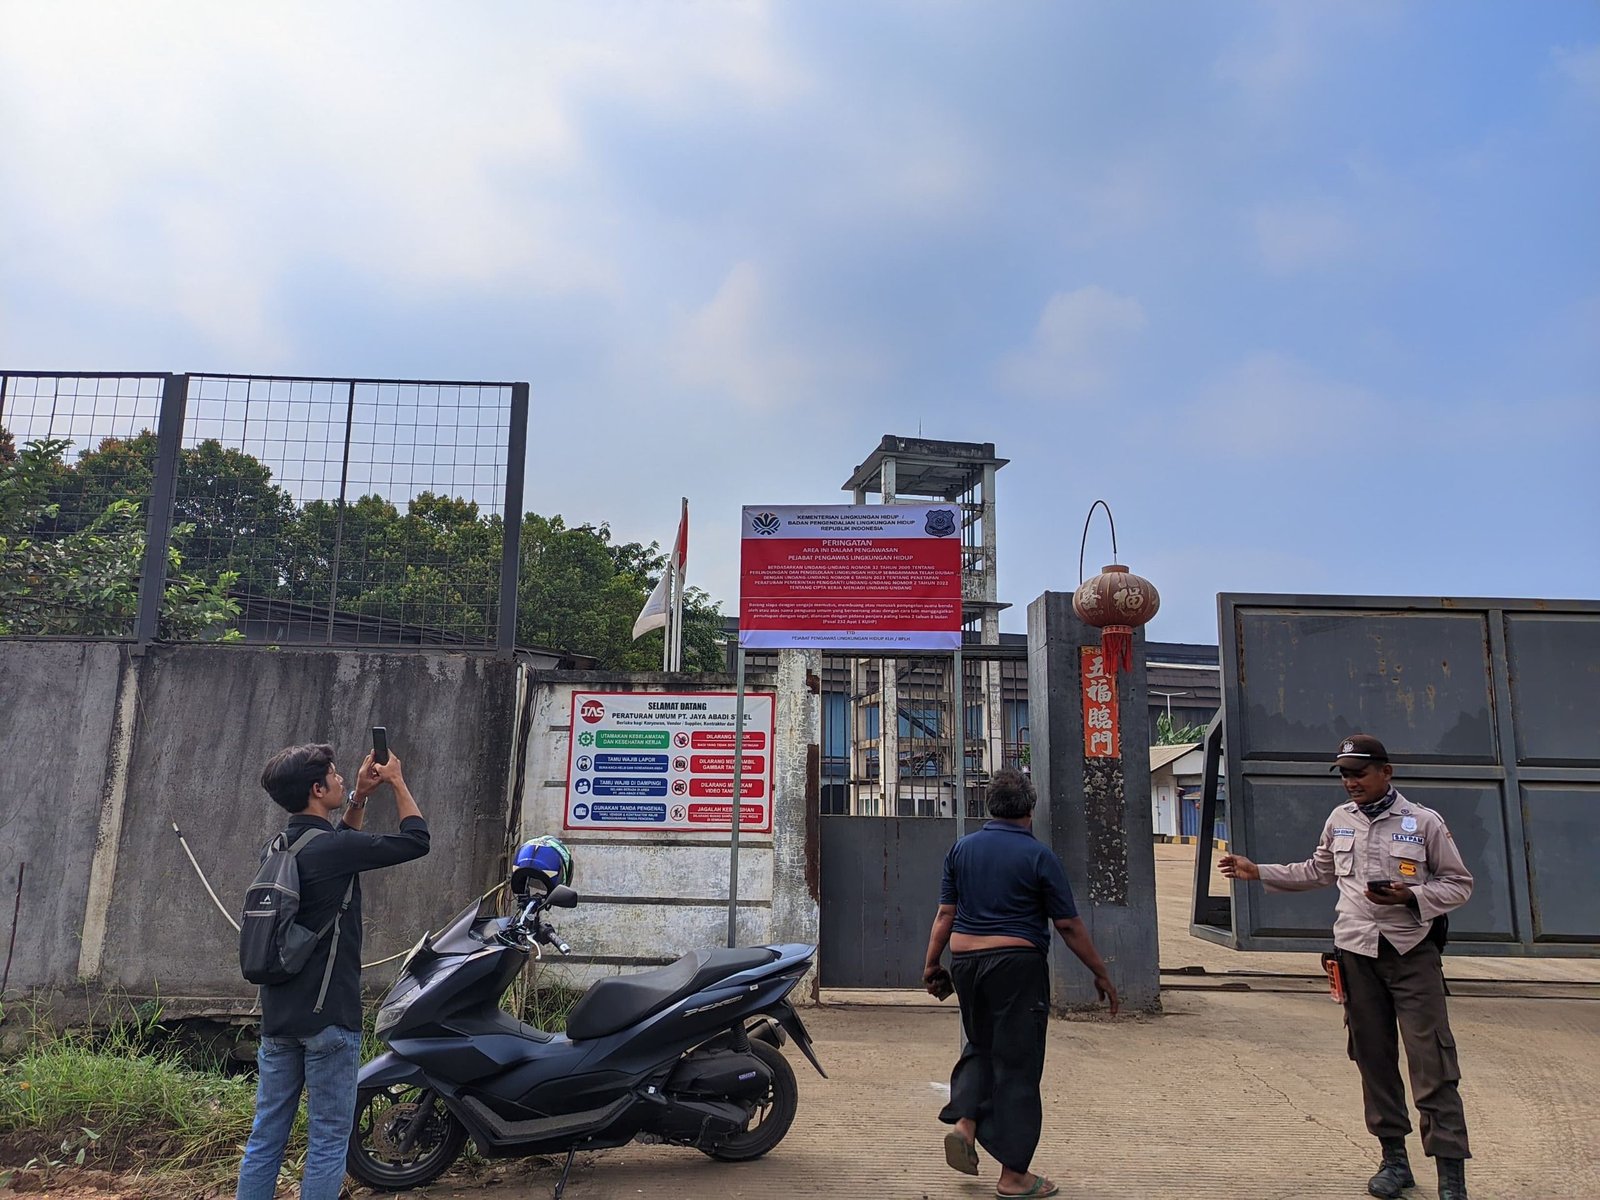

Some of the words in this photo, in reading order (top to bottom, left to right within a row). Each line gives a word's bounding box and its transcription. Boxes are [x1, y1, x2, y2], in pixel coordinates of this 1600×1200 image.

[648, 702, 679, 711] SELAMAT
[680, 702, 707, 711] DATANG
[1085, 656, 1112, 756] 五福臨門
[580, 706, 604, 718] JAS
[1394, 834, 1424, 842] SATPAM
